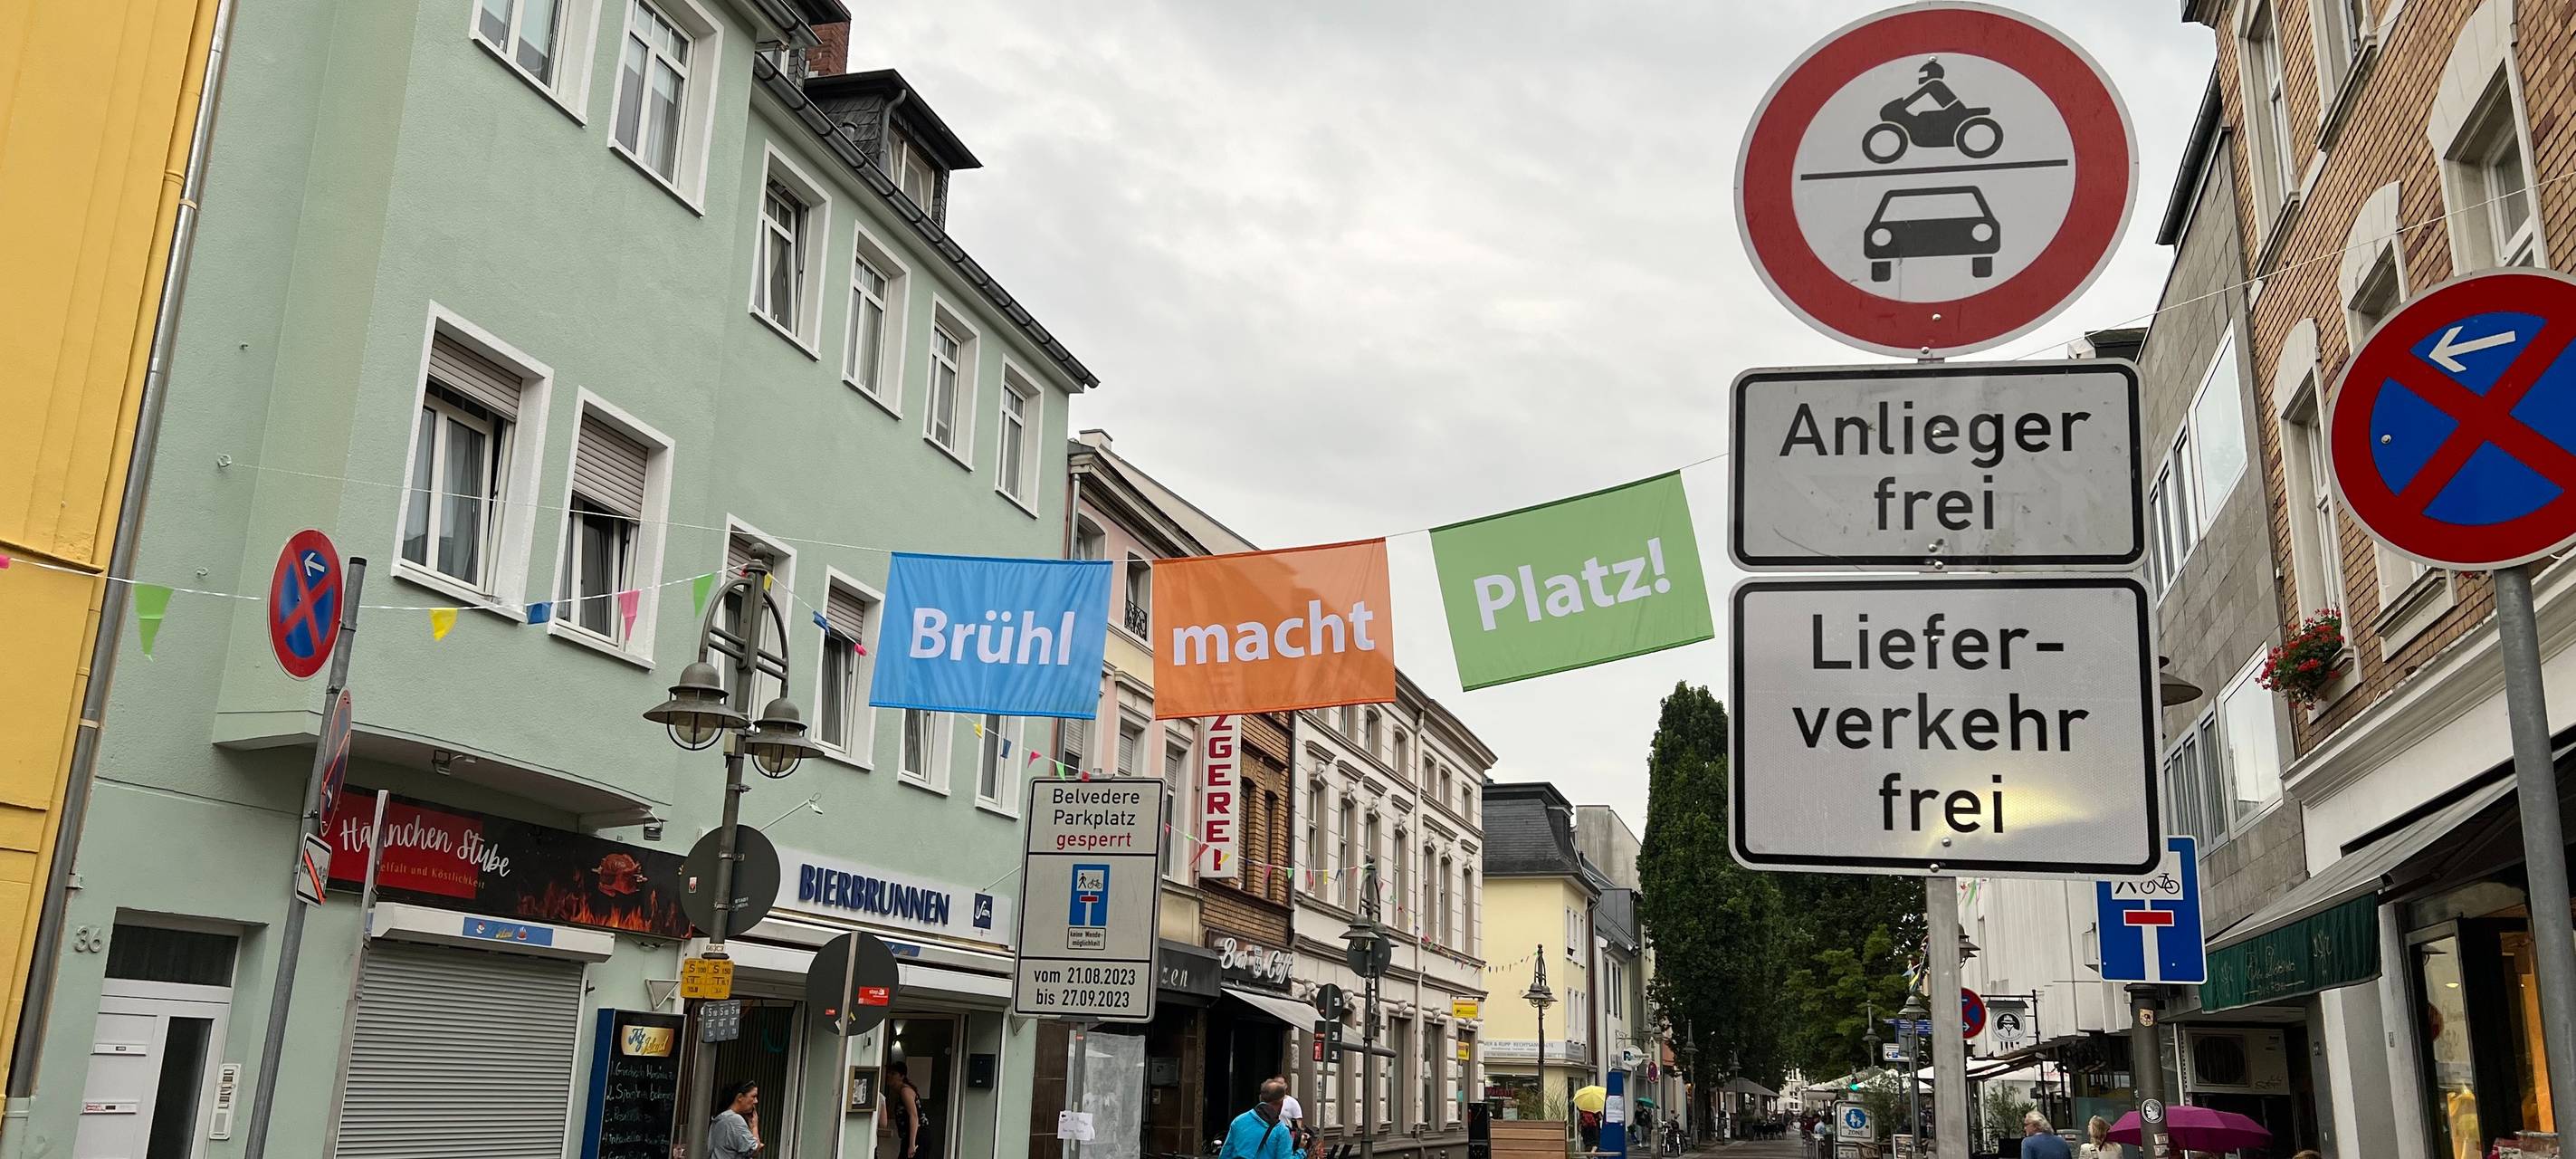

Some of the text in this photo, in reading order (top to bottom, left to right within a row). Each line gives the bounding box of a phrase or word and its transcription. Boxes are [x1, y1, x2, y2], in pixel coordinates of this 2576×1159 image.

[1779, 400, 2092, 469] Anlieger
[1874, 474, 1994, 531] frei
[908, 536, 1673, 667] Brühl macht Platz!
[1812, 613, 2064, 670] Liefer-
[1792, 692, 2090, 752] verkehr
[1053, 788, 1140, 804] Belvedere
[1878, 772, 2004, 834] frei
[1054, 809, 1136, 829] Parkplatz
[339, 814, 511, 877] Hänchen Stube
[1056, 832, 1132, 851] gesperrt
[410, 865, 428, 876] und
[431, 868, 486, 890] Köstlichkeit
[797, 862, 951, 926] BIERBRUNNEN
[74, 925, 102, 953] 36
[1070, 930, 1083, 938] keine
[1072, 939, 1101, 947] möglichkeit
[1221, 937, 1247, 971] Bar
[1034, 967, 1136, 986] vom 21.08.2023
[1035, 988, 1130, 1008] bis 27.09.2023
